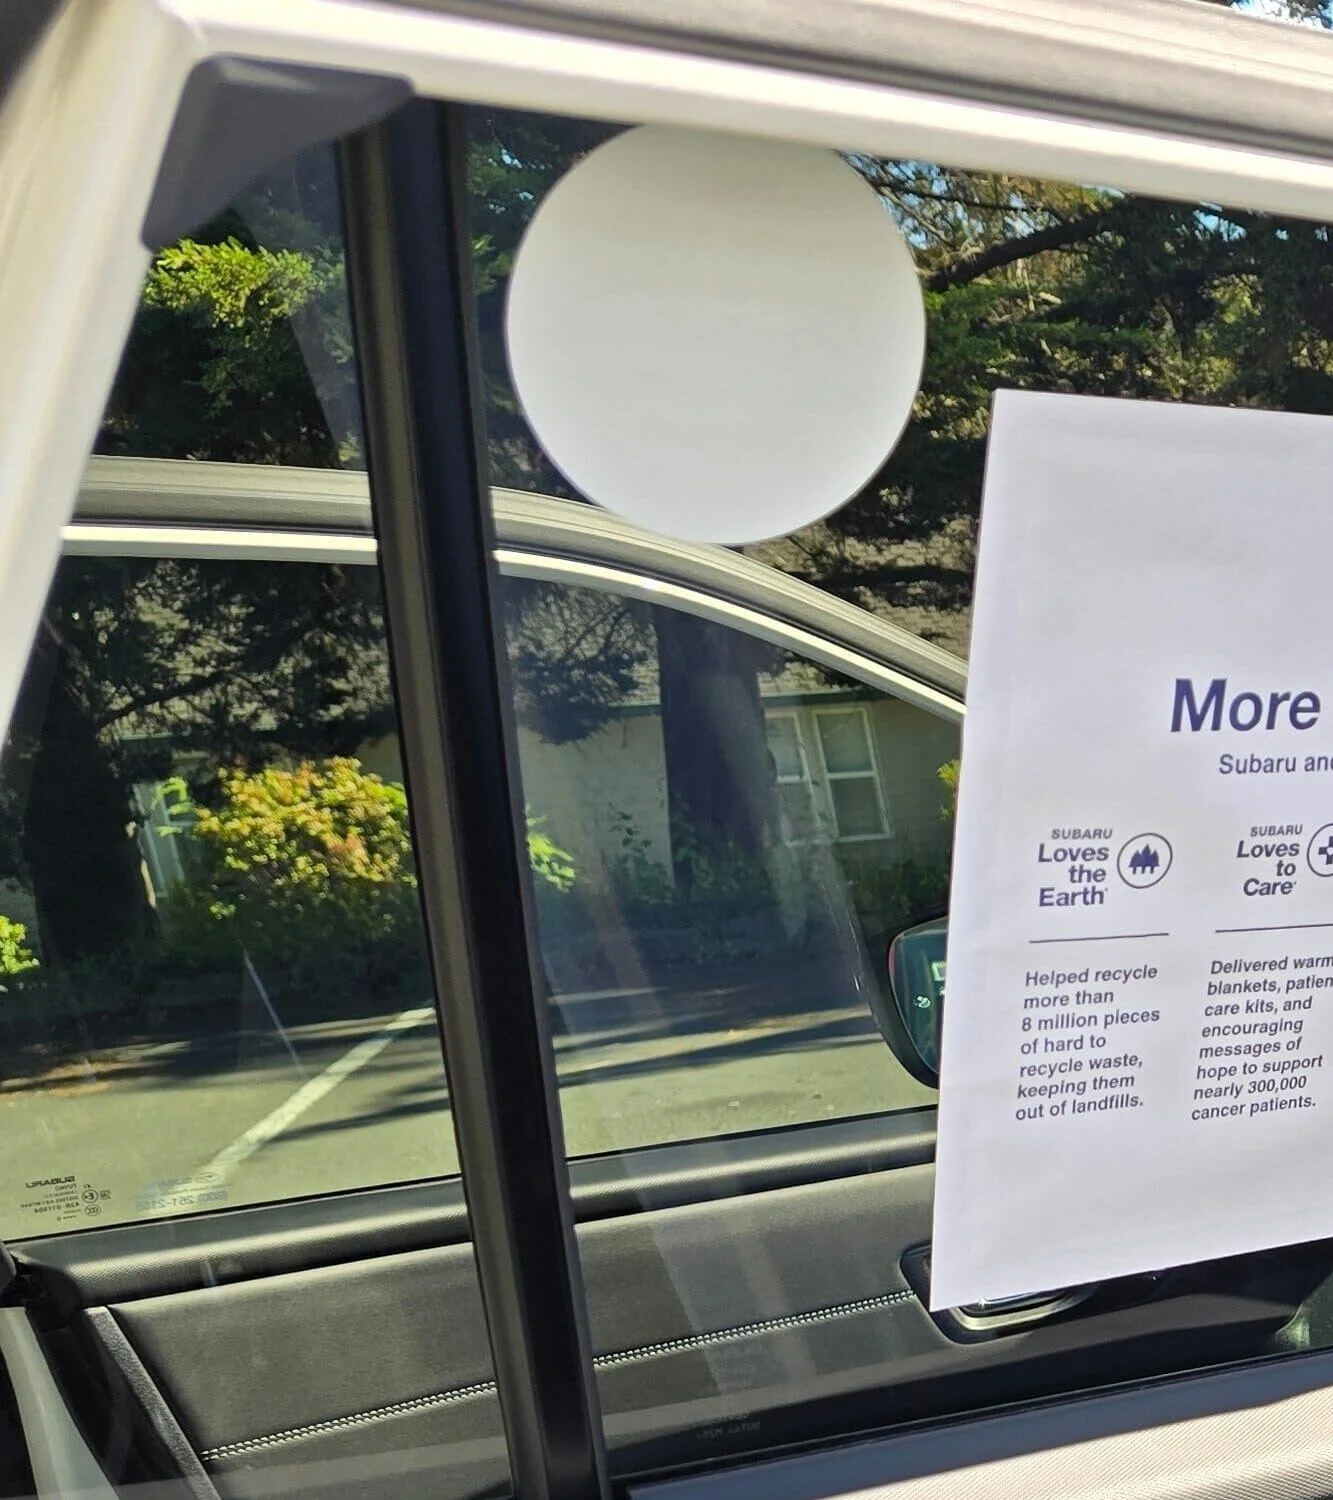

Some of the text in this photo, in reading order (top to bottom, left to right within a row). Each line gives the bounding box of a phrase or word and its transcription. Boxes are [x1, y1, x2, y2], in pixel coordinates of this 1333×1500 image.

[1171, 678, 1321, 732] More
[1219, 753, 1296, 775] Subaru
[1038, 843, 1109, 863] Loves
[1236, 840, 1300, 858] Loves
[1068, 864, 1106, 883] the
[1276, 859, 1296, 877] to
[1025, 964, 1158, 988] Helped recycle
[1210, 956, 1289, 975] Delivered
[1207, 978, 1281, 996] blankets,
[1024, 990, 1114, 1009] more than
[1204, 995, 1313, 1016] care kits, and
[1021, 1009, 1160, 1032] 8 million pieces
[1201, 1017, 1303, 1038] encouraging
[1020, 1034, 1106, 1055] of hard to
[1199, 1036, 1303, 1059] messages of
[1020, 1053, 1143, 1079] recycle waste,
[1196, 1054, 1323, 1081] hope to support
[1017, 1075, 1135, 1099] keeping them
[1193, 1075, 1307, 1100] nearly 300,000
[1015, 1093, 1143, 1120] out of landfills.
[1191, 1095, 1316, 1120] cancer patients.
